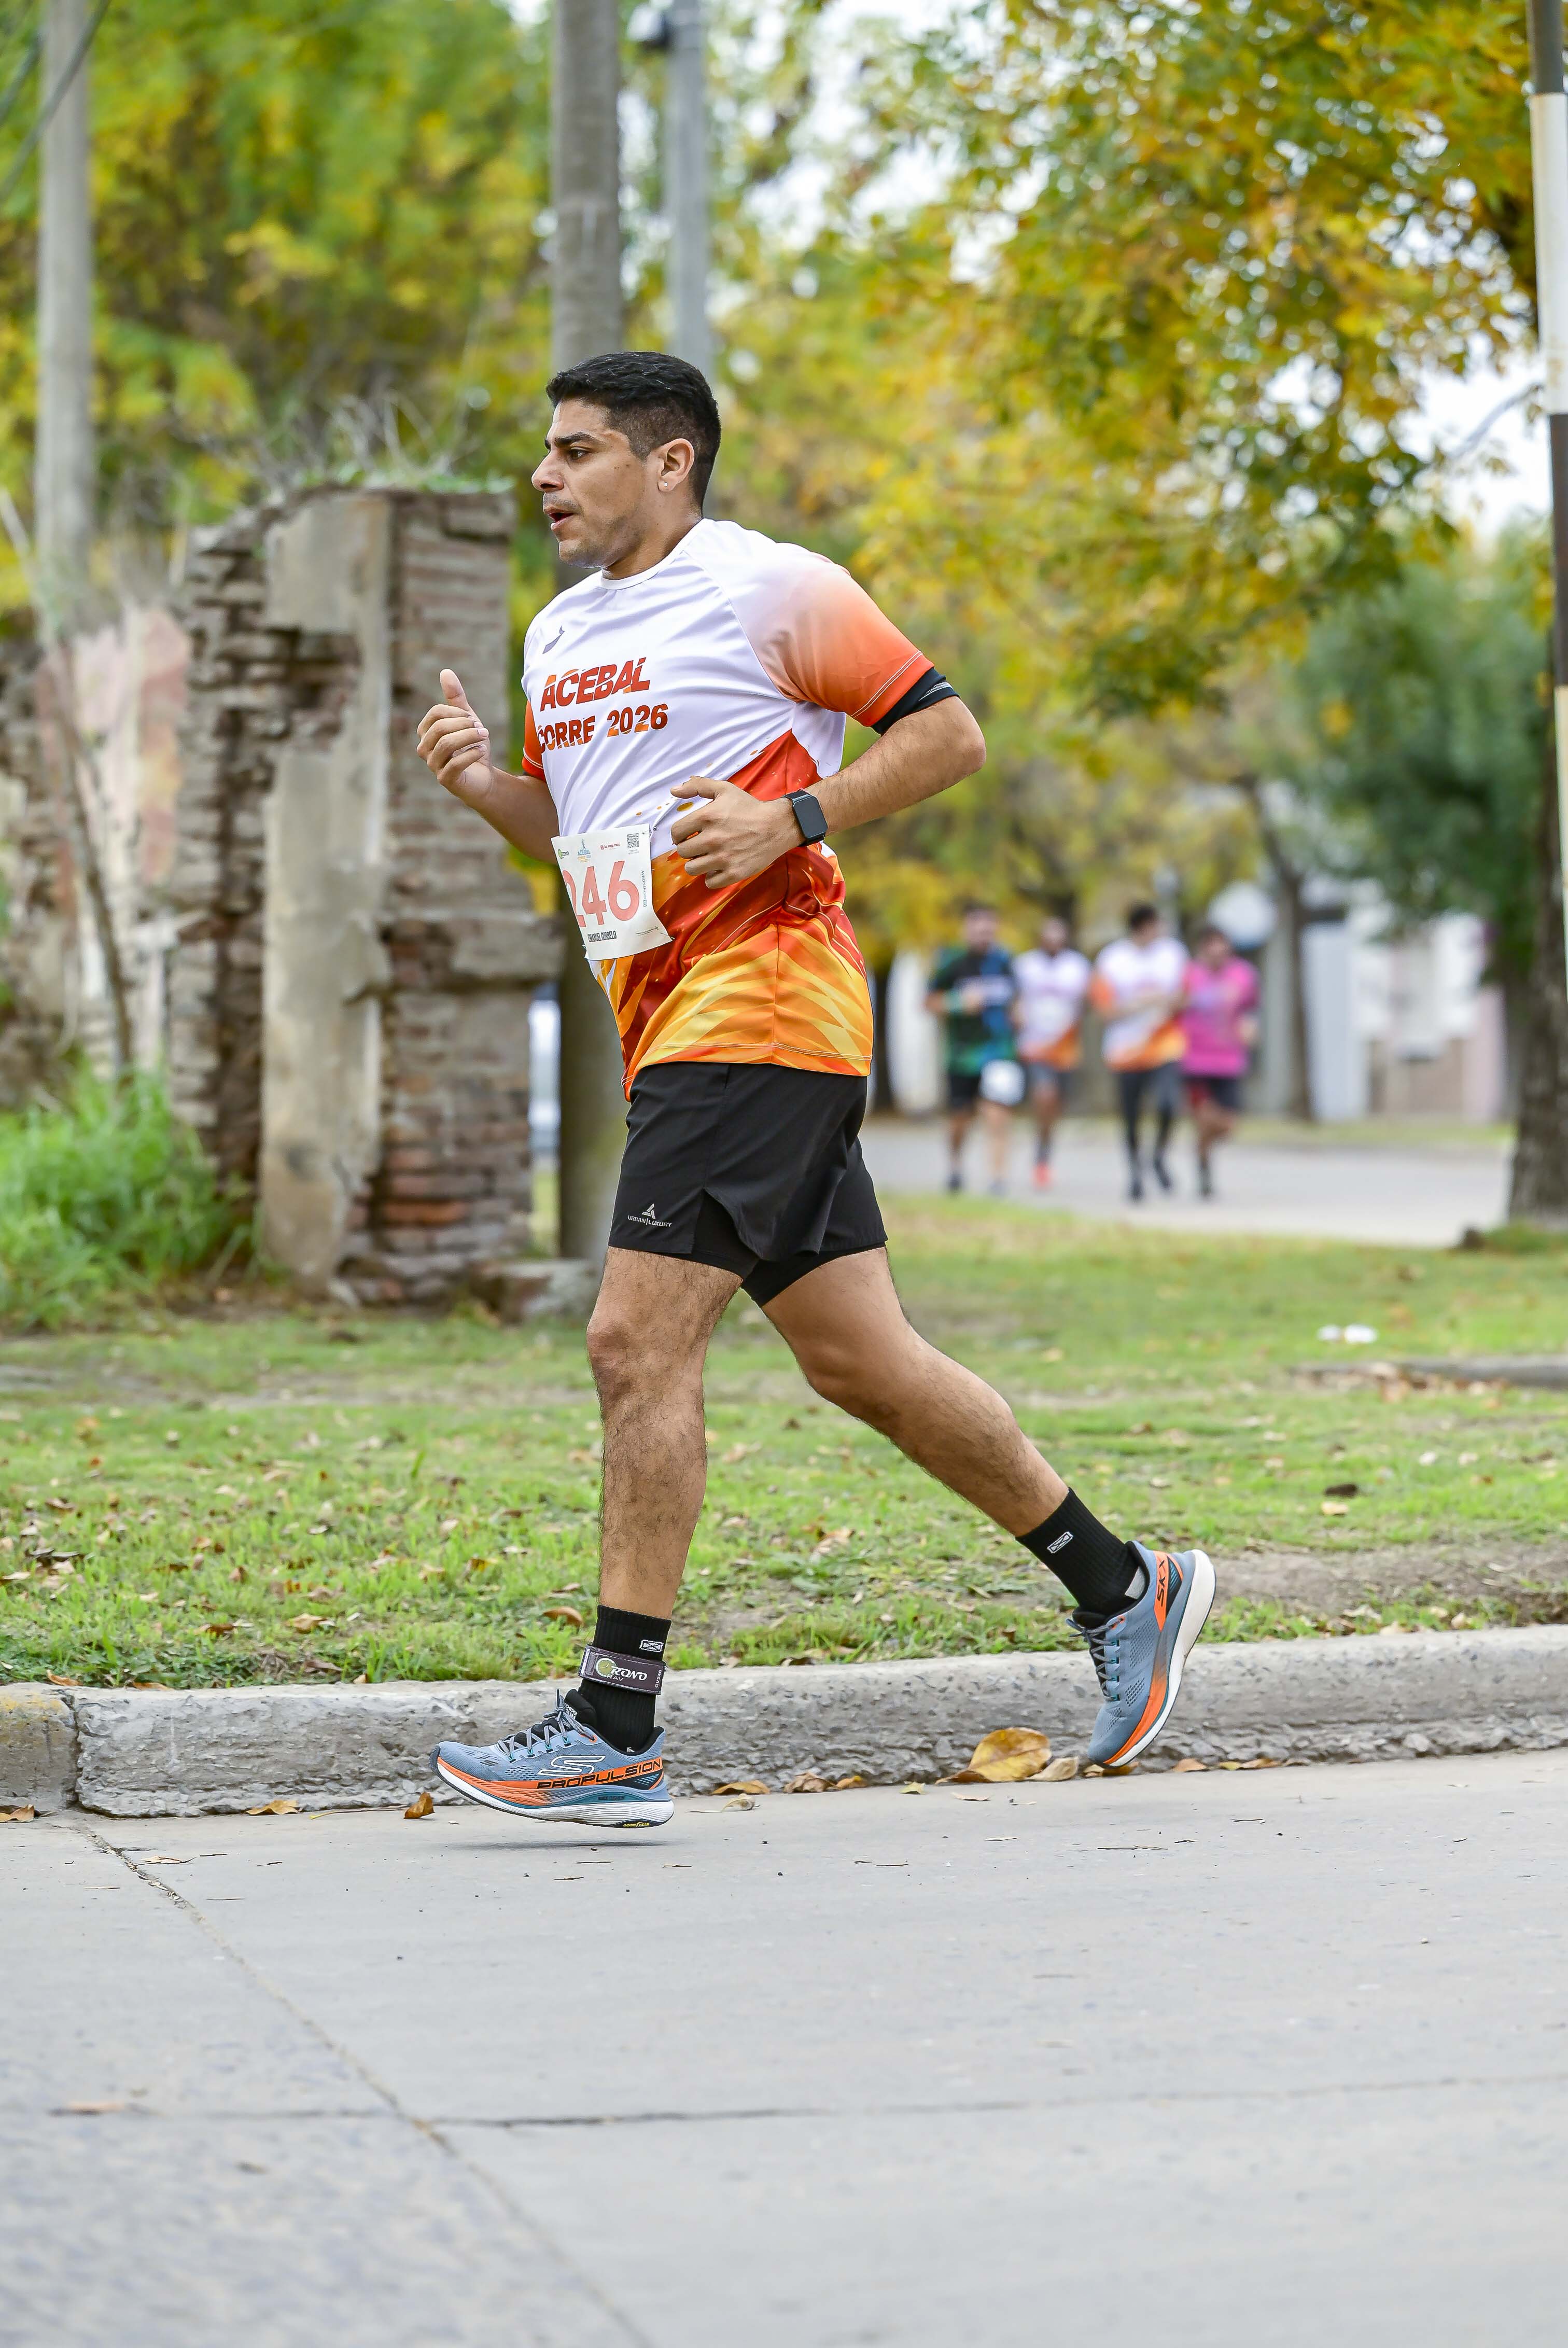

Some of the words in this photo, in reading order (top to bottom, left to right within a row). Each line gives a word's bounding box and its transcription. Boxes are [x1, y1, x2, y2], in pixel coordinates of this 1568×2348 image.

[540, 657, 650, 711] ACEBAL
[607, 704, 668, 737] 2026
[537, 1758, 661, 1789] PROPULSION
